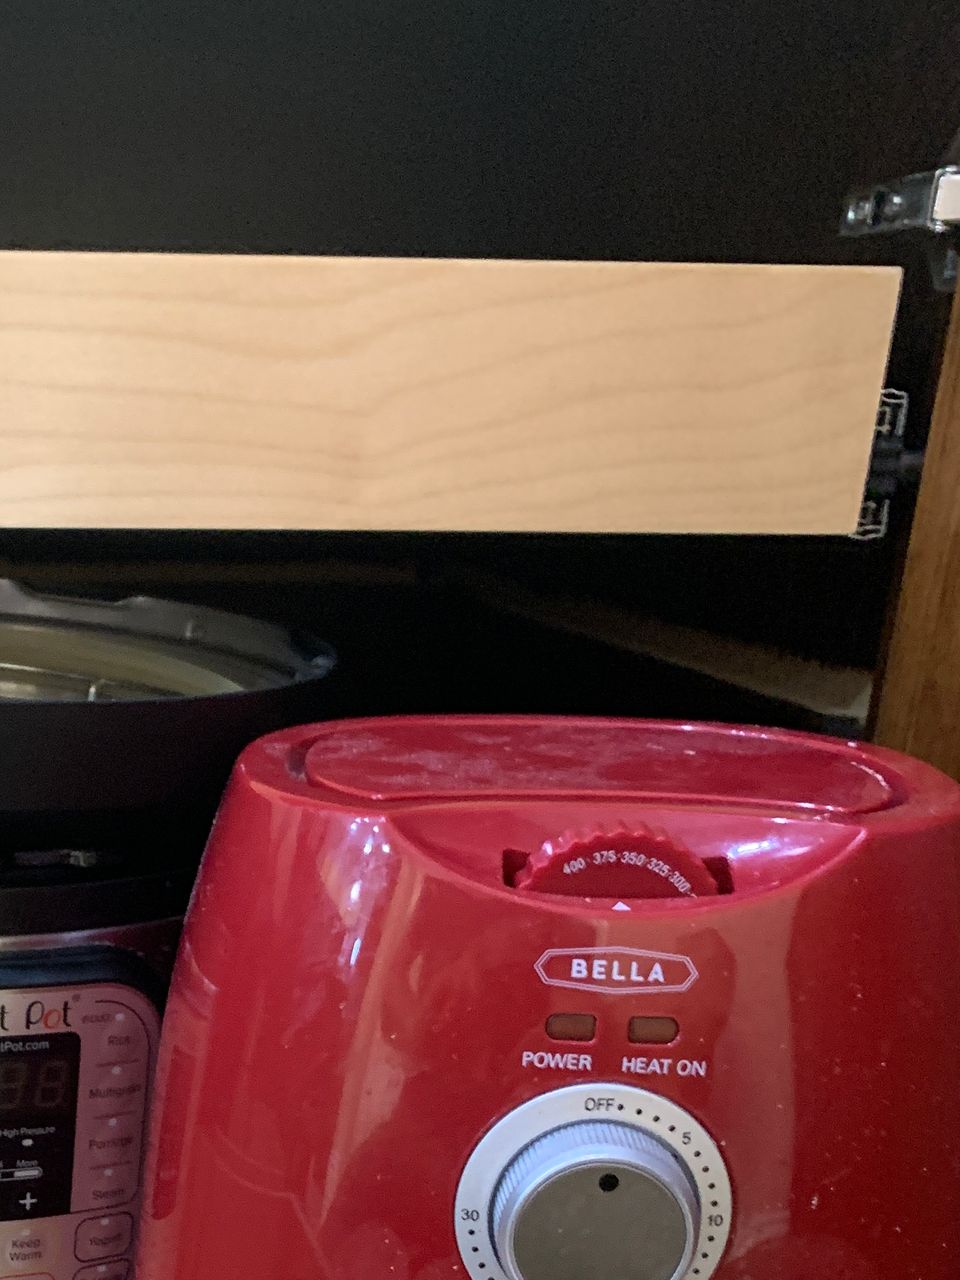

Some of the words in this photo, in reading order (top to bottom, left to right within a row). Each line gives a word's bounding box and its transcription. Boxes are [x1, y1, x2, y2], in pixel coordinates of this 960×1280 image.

[563, 857, 586, 874] 400
[592, 850, 617, 864] 375
[620, 851, 646, 866] 350
[646, 857, 672, 877] 325
[669, 871, 691, 893] 300
[570, 958, 666, 983] BELLA
[25, 1000, 71, 1030] Pot
[522, 1051, 592, 1071] POWER
[622, 1056, 670, 1075] HEAT
[676, 1059, 707, 1078] ON
[584, 1097, 614, 1112] OFF
[0, 1129, 19, 1139] High
[20, 1126, 56, 1136] Pressure
[682, 1131, 691, 1145] 5
[461, 1208, 480, 1221] 30
[707, 1214, 723, 1226] 10
[11, 1238, 40, 1251] Keep
[9, 1250, 42, 1262] Warm
